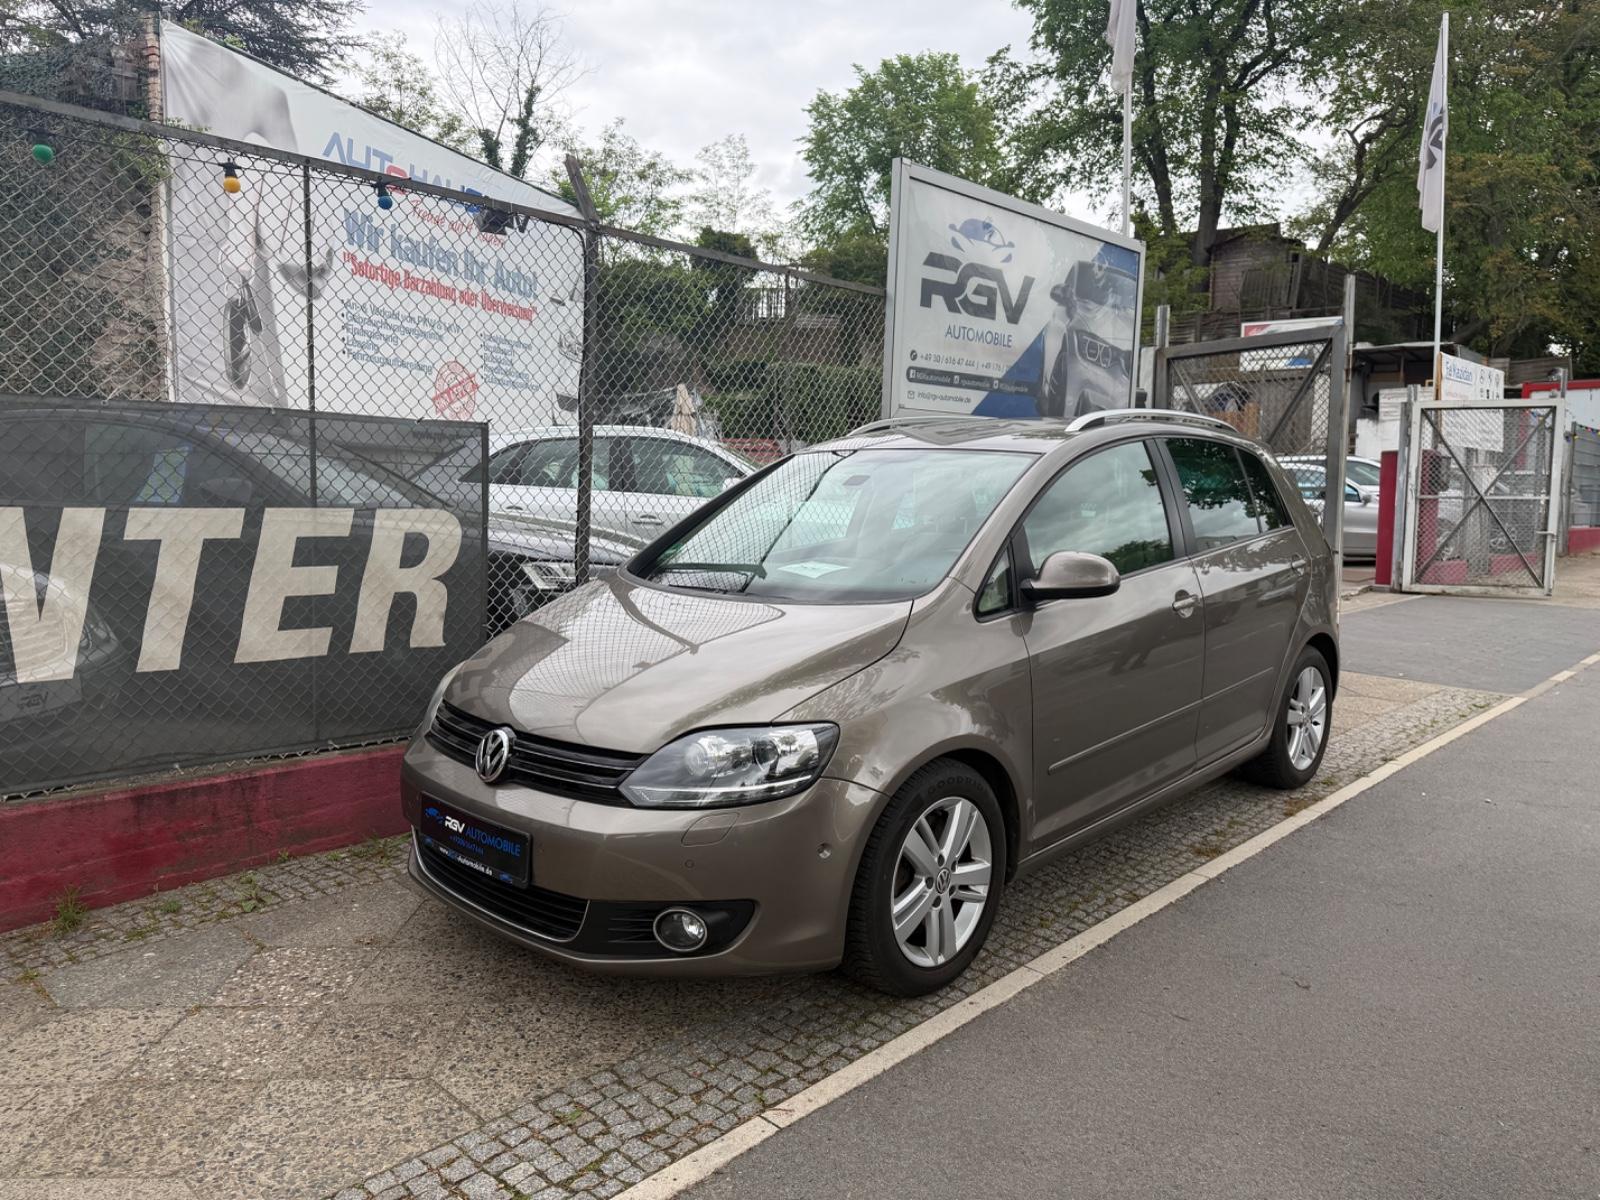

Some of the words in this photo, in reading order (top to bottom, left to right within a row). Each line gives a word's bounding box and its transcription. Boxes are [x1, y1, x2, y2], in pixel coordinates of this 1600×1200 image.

[344, 207, 384, 254] Wir
[390, 223, 459, 278] kaufen
[920, 251, 1036, 325] RGV
[945, 324, 1013, 348] AUTOMOBILE
[444, 815, 465, 833] RGV
[465, 826, 521, 857] AUTOMOBILE
